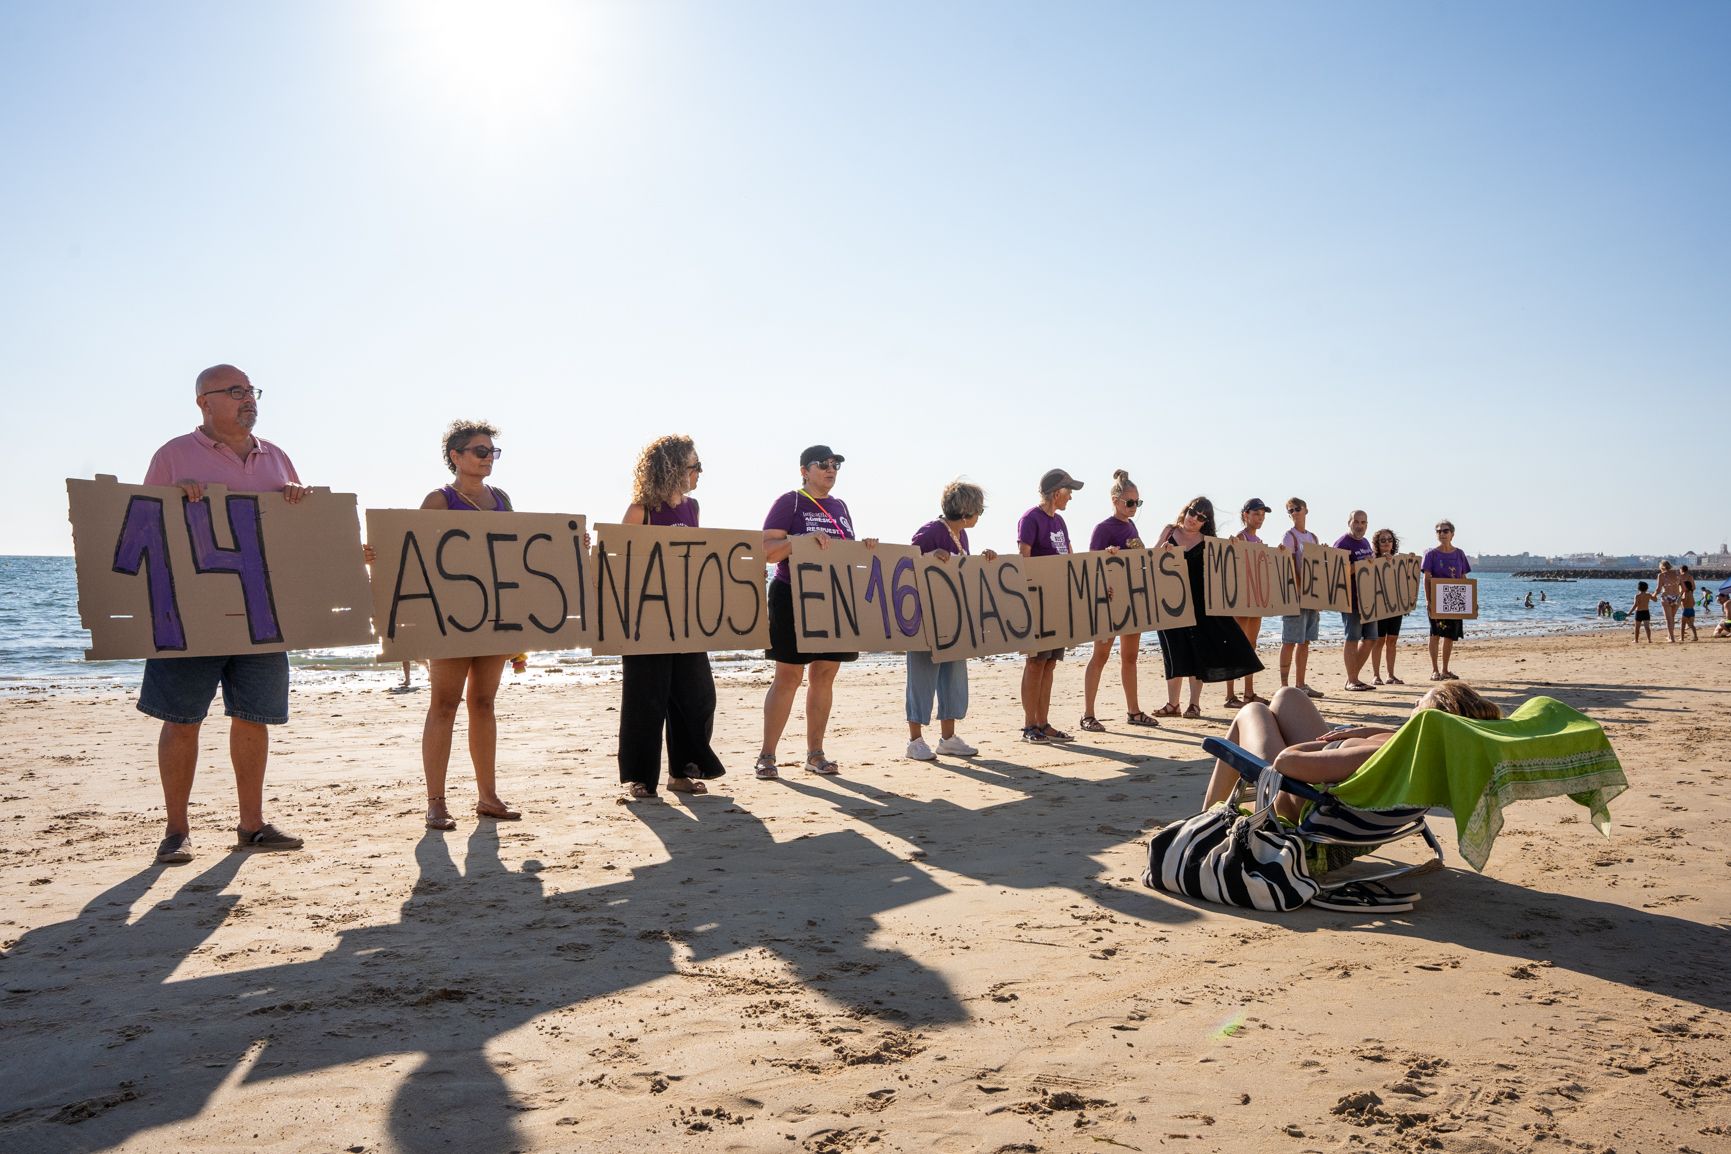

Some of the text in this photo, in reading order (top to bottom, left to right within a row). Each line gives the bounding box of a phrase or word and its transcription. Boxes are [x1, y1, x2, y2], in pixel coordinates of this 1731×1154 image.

[111, 493, 284, 653] 14
[797, 555, 923, 640] EN 16
[924, 556, 1032, 651] DÍAS
[1244, 548, 1270, 609] NO
[1274, 555, 1300, 605] VA
[1302, 556, 1319, 599] DE
